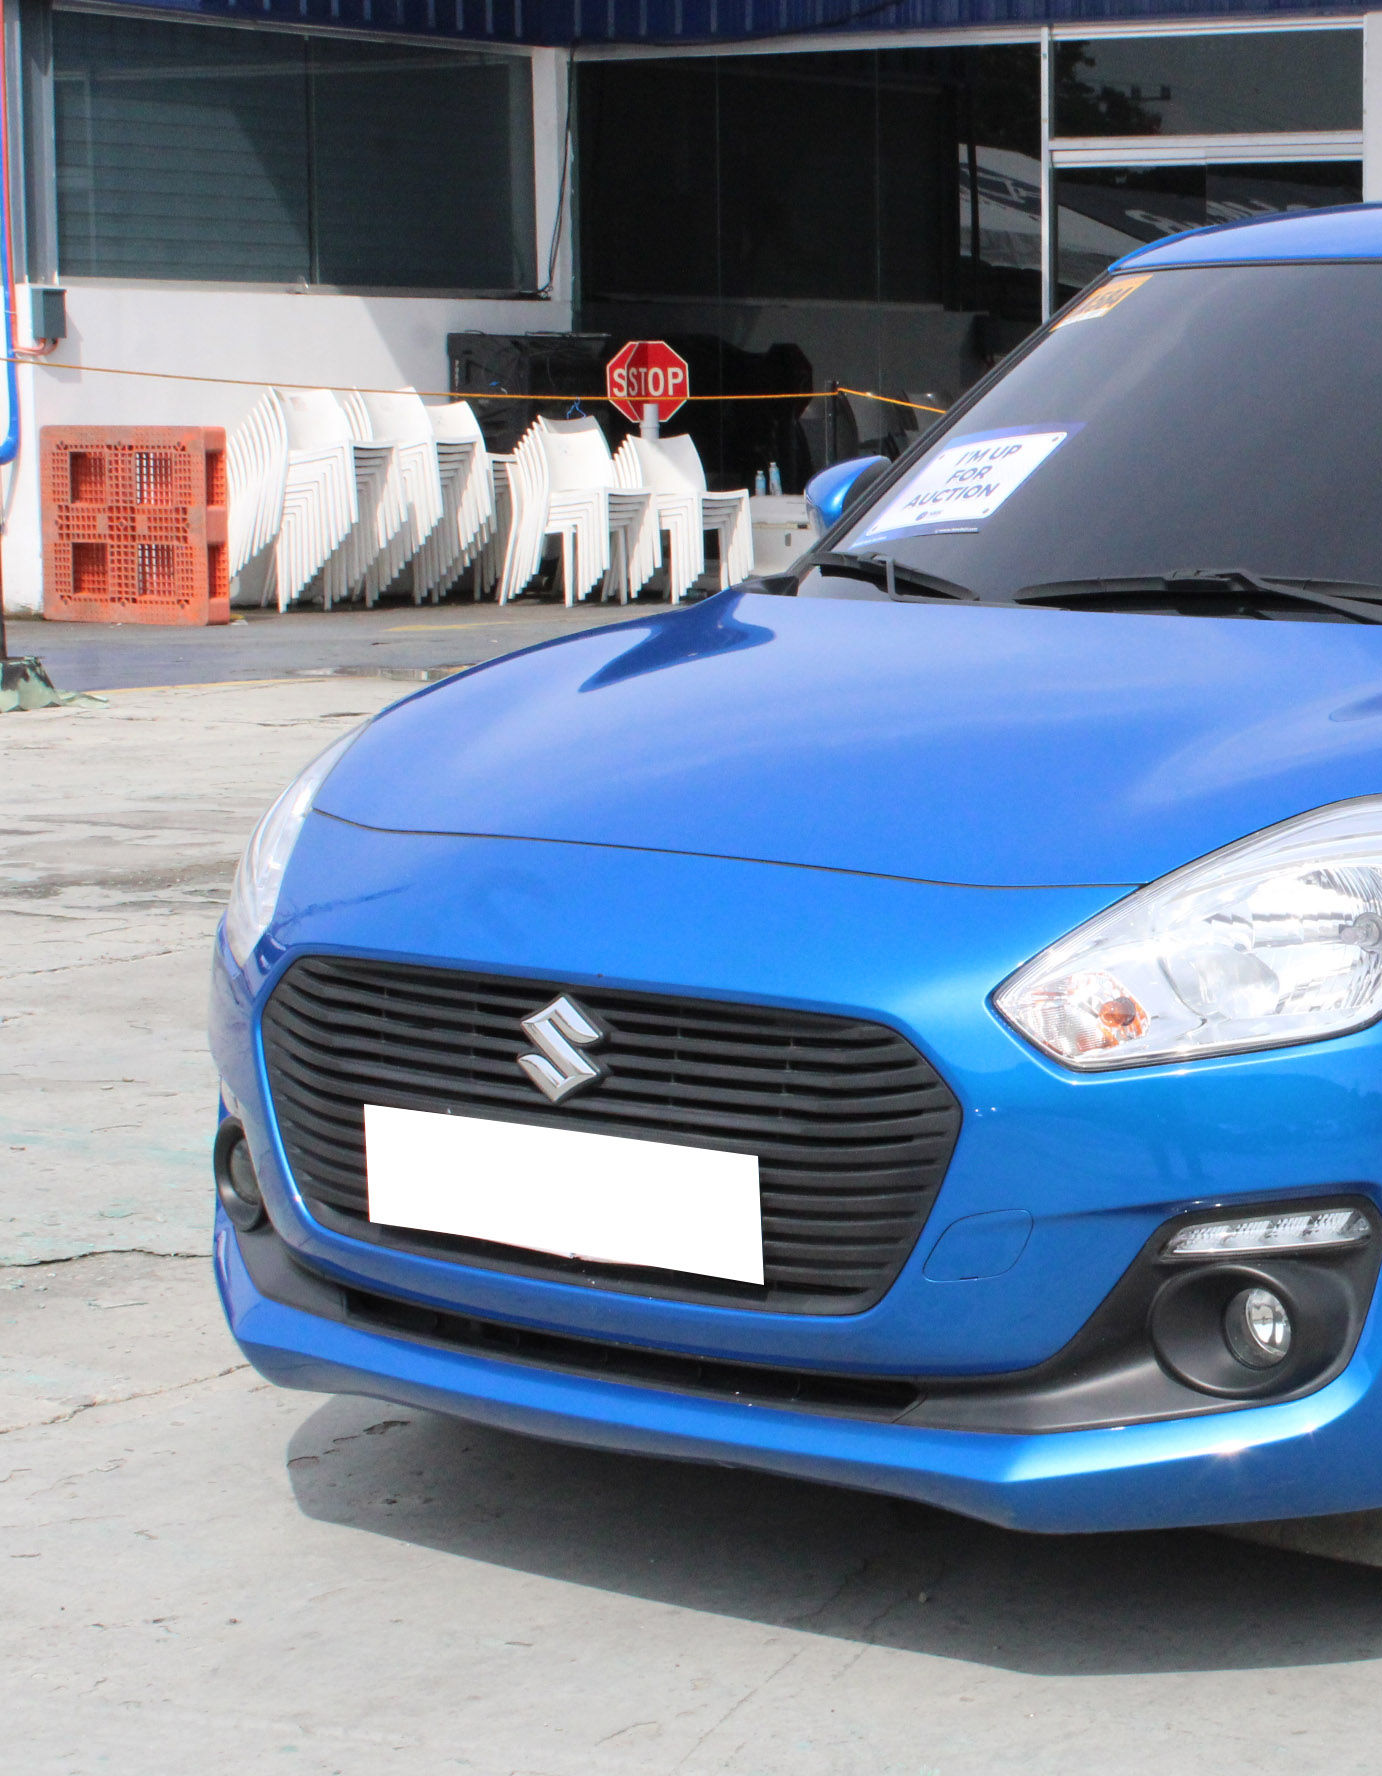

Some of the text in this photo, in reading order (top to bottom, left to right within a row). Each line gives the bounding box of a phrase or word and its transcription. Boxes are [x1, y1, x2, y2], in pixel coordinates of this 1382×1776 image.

[956, 445, 1022, 465] I'M UP
[946, 466, 992, 484] FOR
[904, 483, 999, 509] AUCTION
